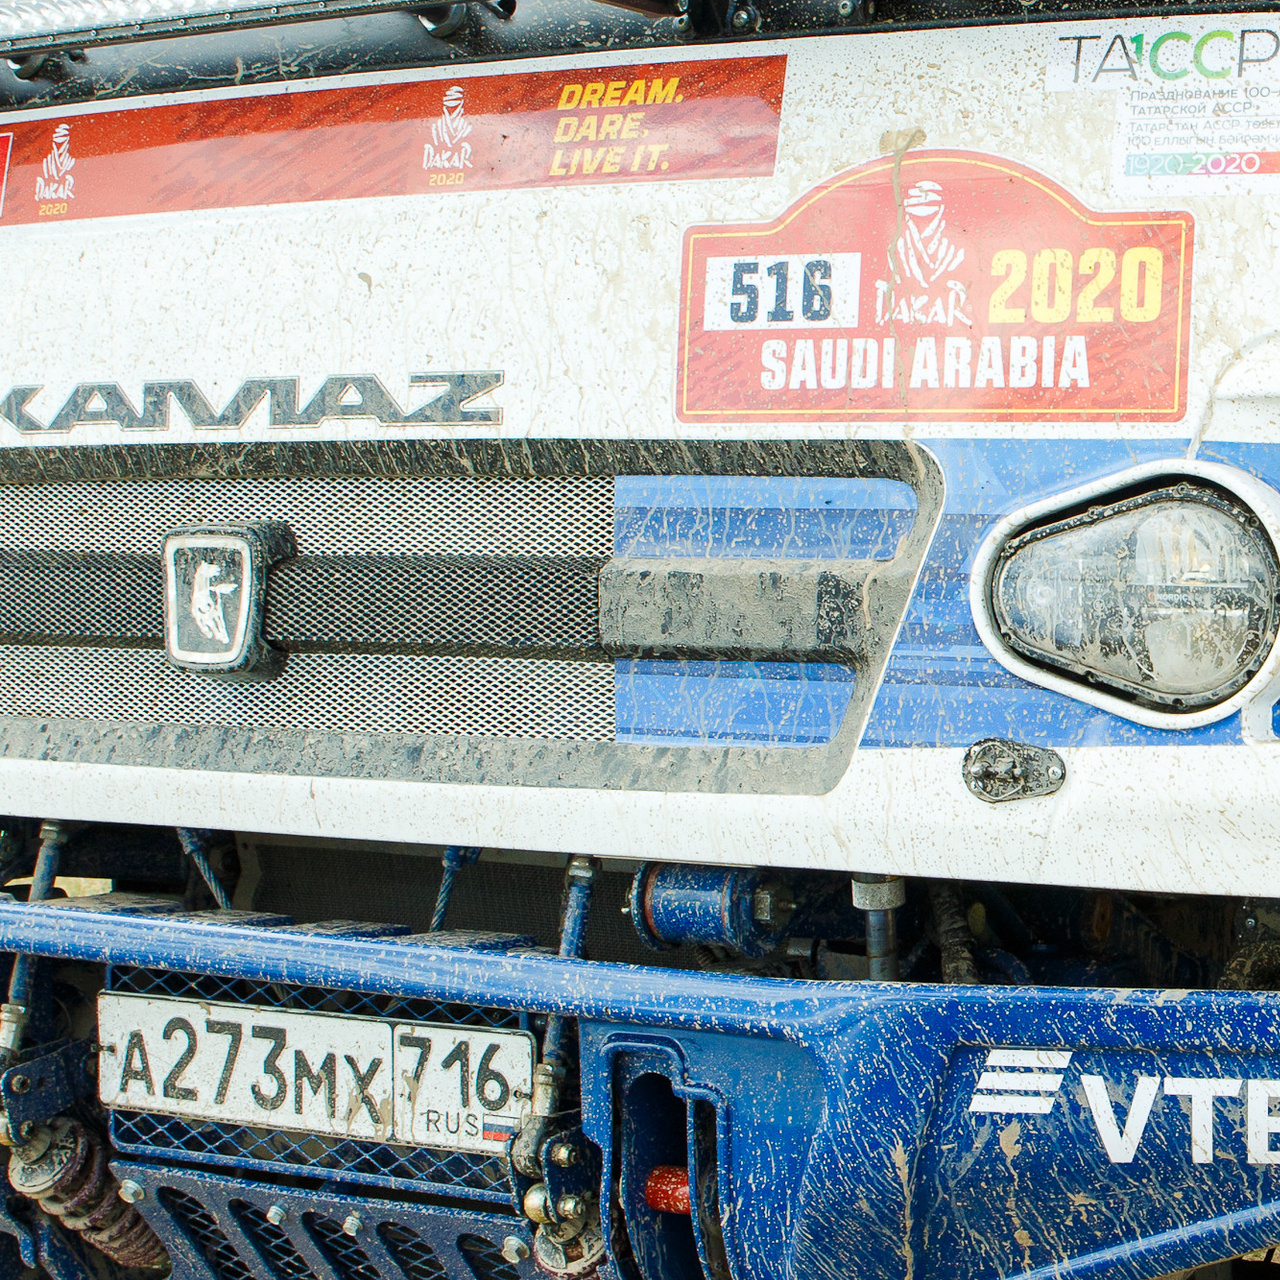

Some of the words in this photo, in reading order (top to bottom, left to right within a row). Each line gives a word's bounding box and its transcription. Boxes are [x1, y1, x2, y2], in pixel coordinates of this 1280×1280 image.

[557, 77, 684, 111] DREAM.
[1130, 102, 1207, 116] ТАТАРСКОЙ
[1211, 101, 1252, 115] АССР
[553, 112, 649, 144] DARE.
[422, 142, 473, 170] DAKAR
[549, 146, 627, 176] LIVE
[630, 144, 669, 172] IT.
[1128, 152, 1261, 176] 1920-2020
[34, 174, 75, 202] DAKAR
[428, 172, 465, 187] 2020
[38, 203, 68, 216] 2020
[729, 259, 834, 324] 516
[987, 246, 1165, 325] 2020
[875, 279, 973, 328] DAKAR
[760, 337, 897, 391] SAUDI
[908, 335, 1091, 390] ARABIA
[399, 1034, 511, 1112] 716
[425, 1107, 480, 1137] RUS
